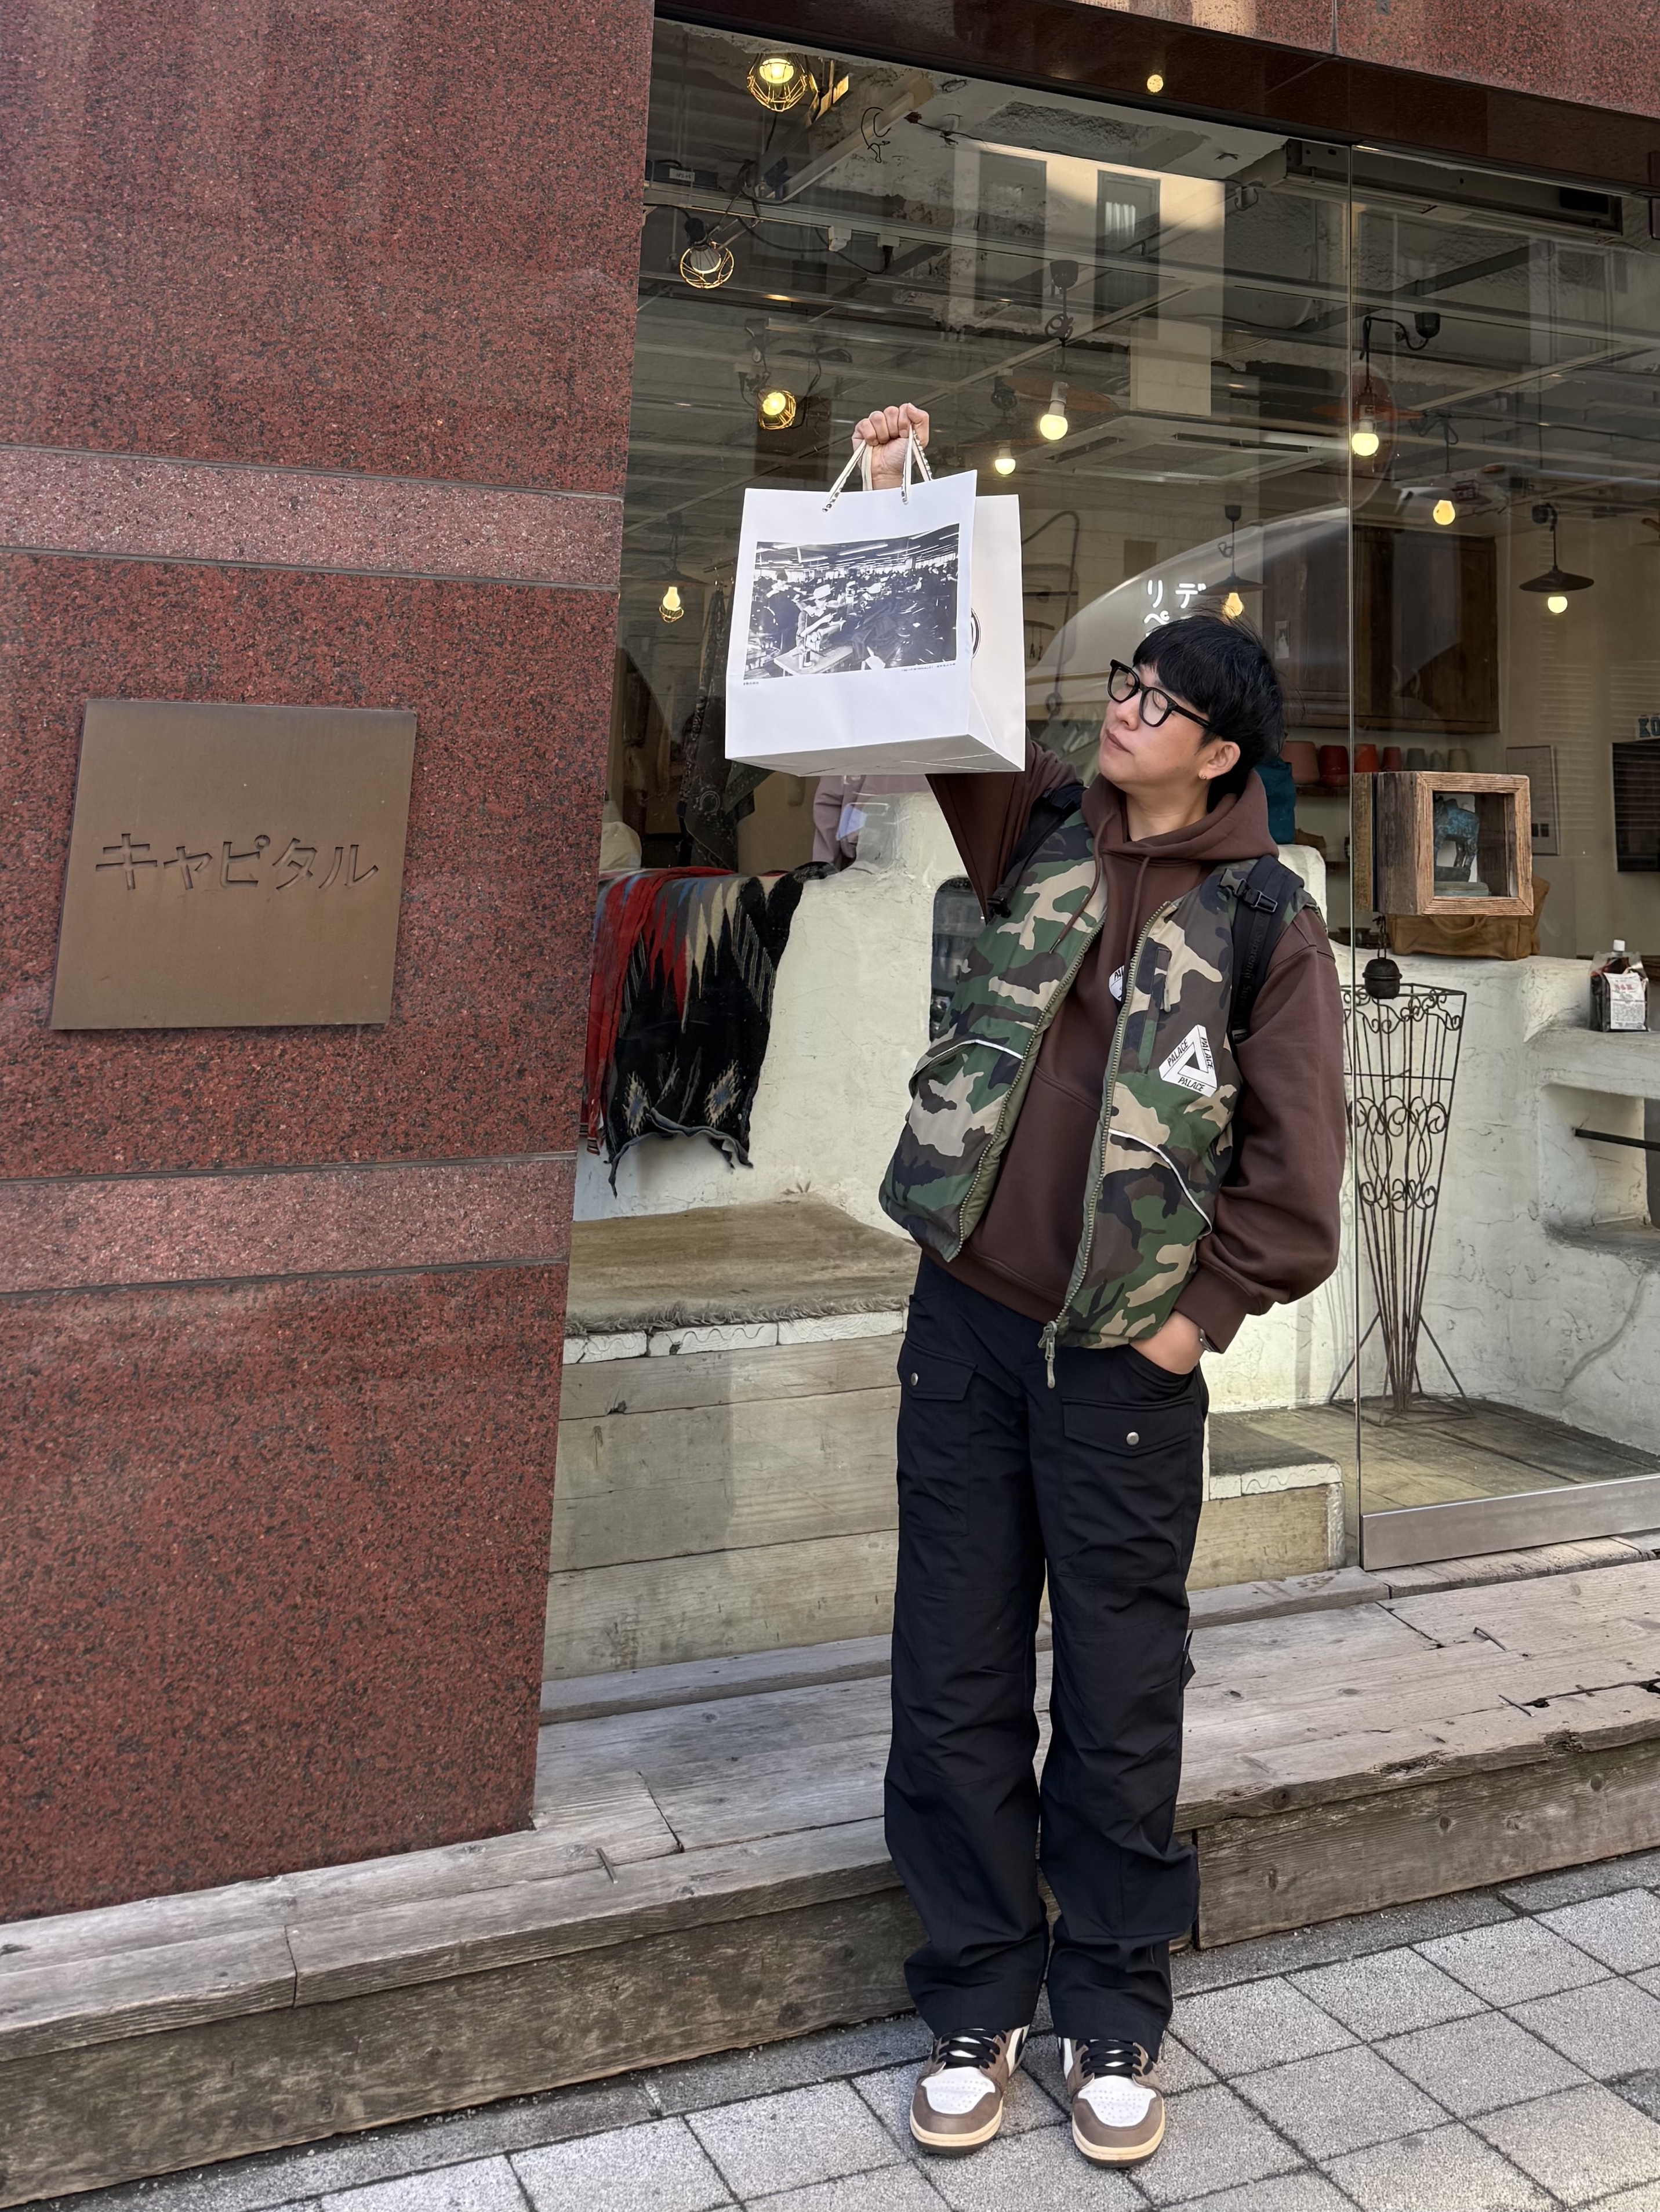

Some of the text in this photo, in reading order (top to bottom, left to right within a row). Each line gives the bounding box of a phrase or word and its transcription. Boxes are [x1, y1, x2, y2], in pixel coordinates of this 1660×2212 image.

[96, 833, 379, 890] キャピタル
[1167, 1038, 1189, 1067] PALACE
[1201, 1037, 1215, 1070] PALACE
[1178, 1077, 1205, 1092] PALACE
